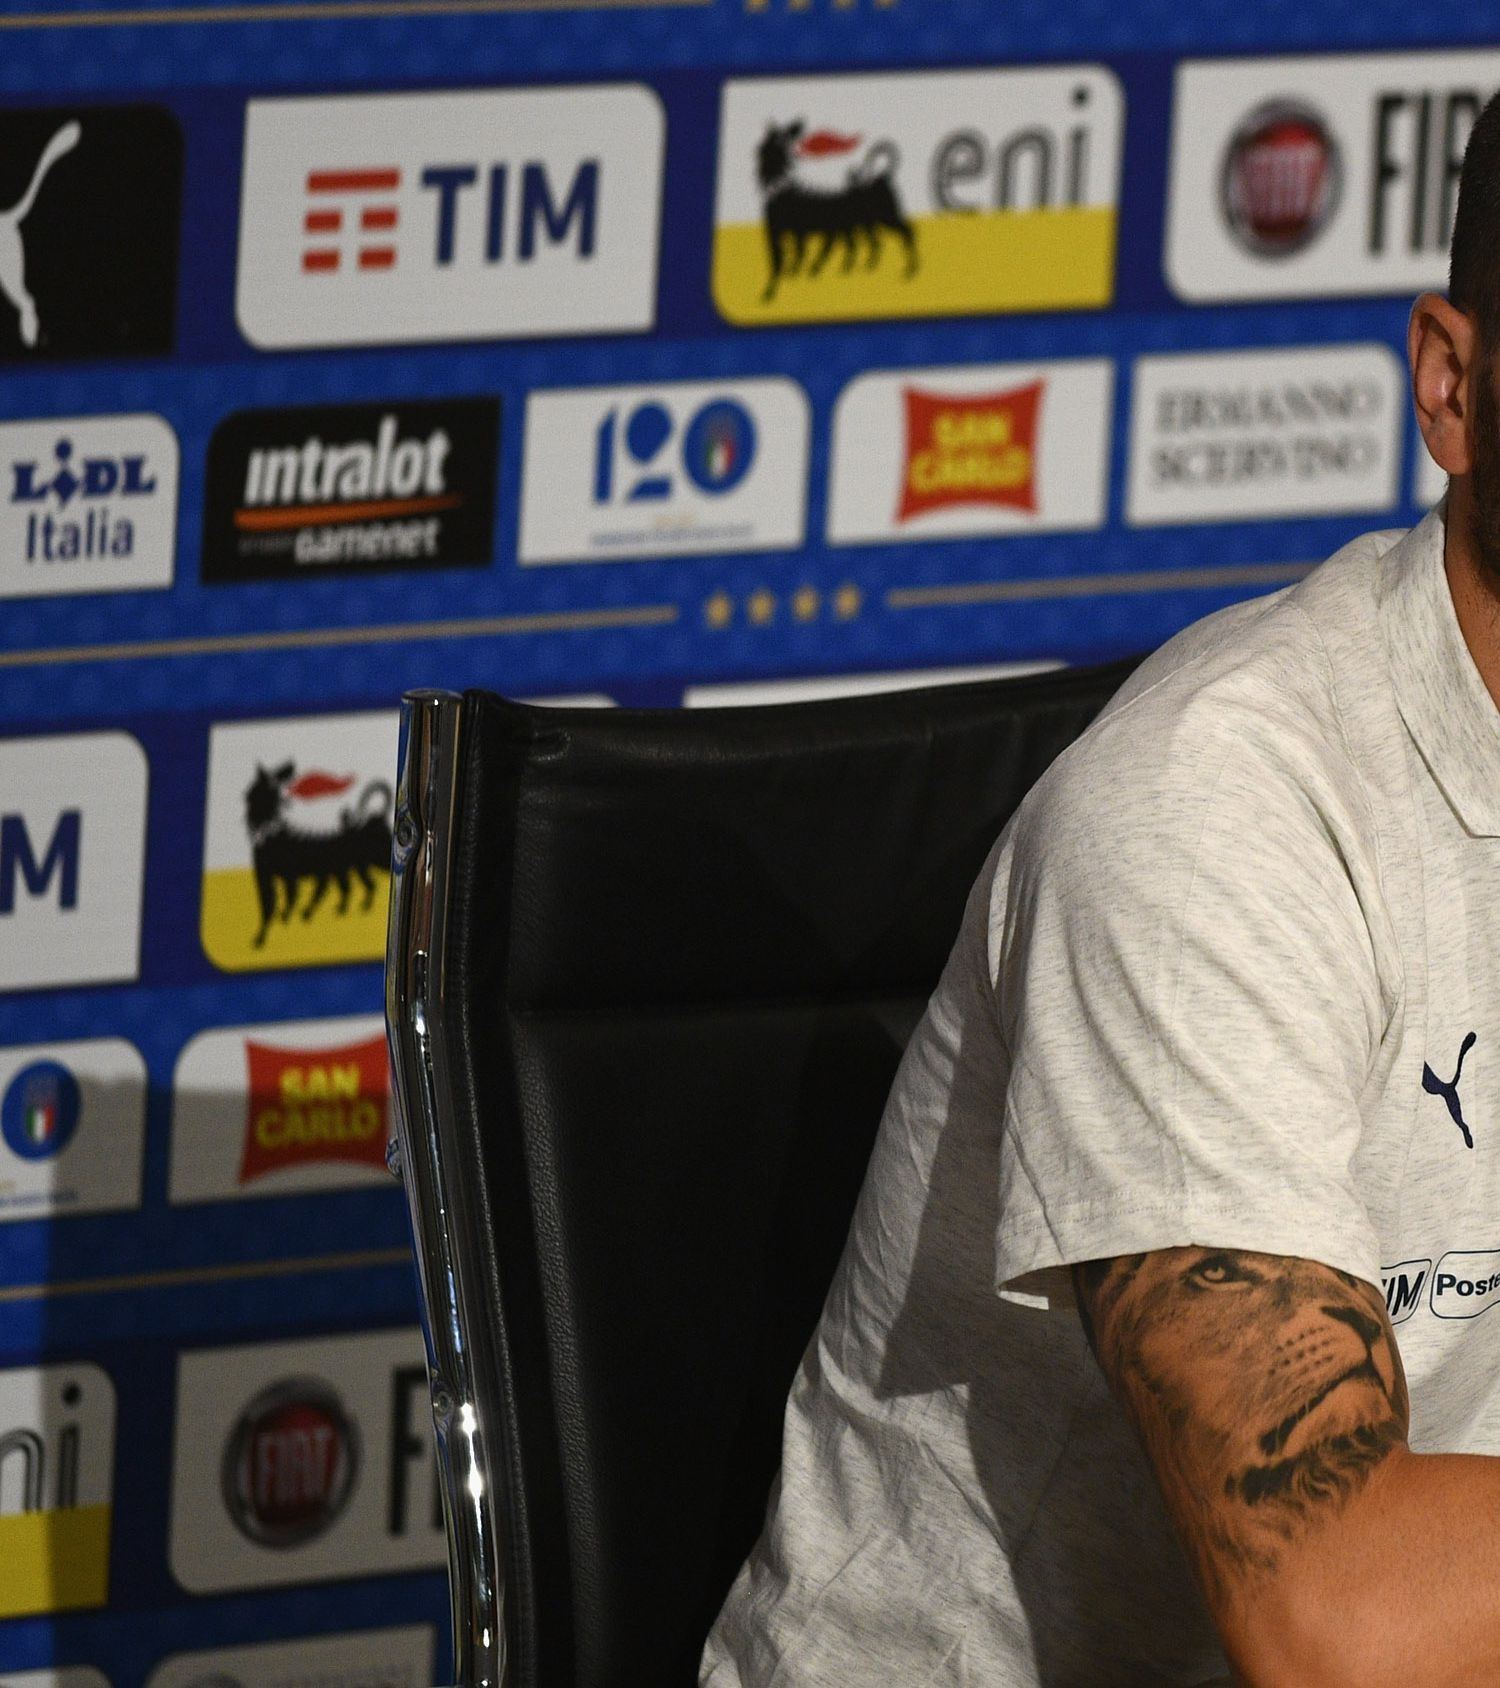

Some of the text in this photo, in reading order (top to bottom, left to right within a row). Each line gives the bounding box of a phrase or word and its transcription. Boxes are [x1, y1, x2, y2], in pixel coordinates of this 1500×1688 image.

[927, 83, 1091, 217] eni
[420, 157, 603, 268] TIM
[592, 396, 758, 506] 120
[934, 408, 1012, 448] SAN
[244, 413, 449, 505] intralot
[910, 445, 1032, 494] CARLO
[26, 506, 134, 564] Italia
[279, 1062, 362, 1104] SAN
[256, 1101, 382, 1149] CARLO
[1381, 1269, 1426, 1317] IM
[0, 1382, 82, 1515] ni
